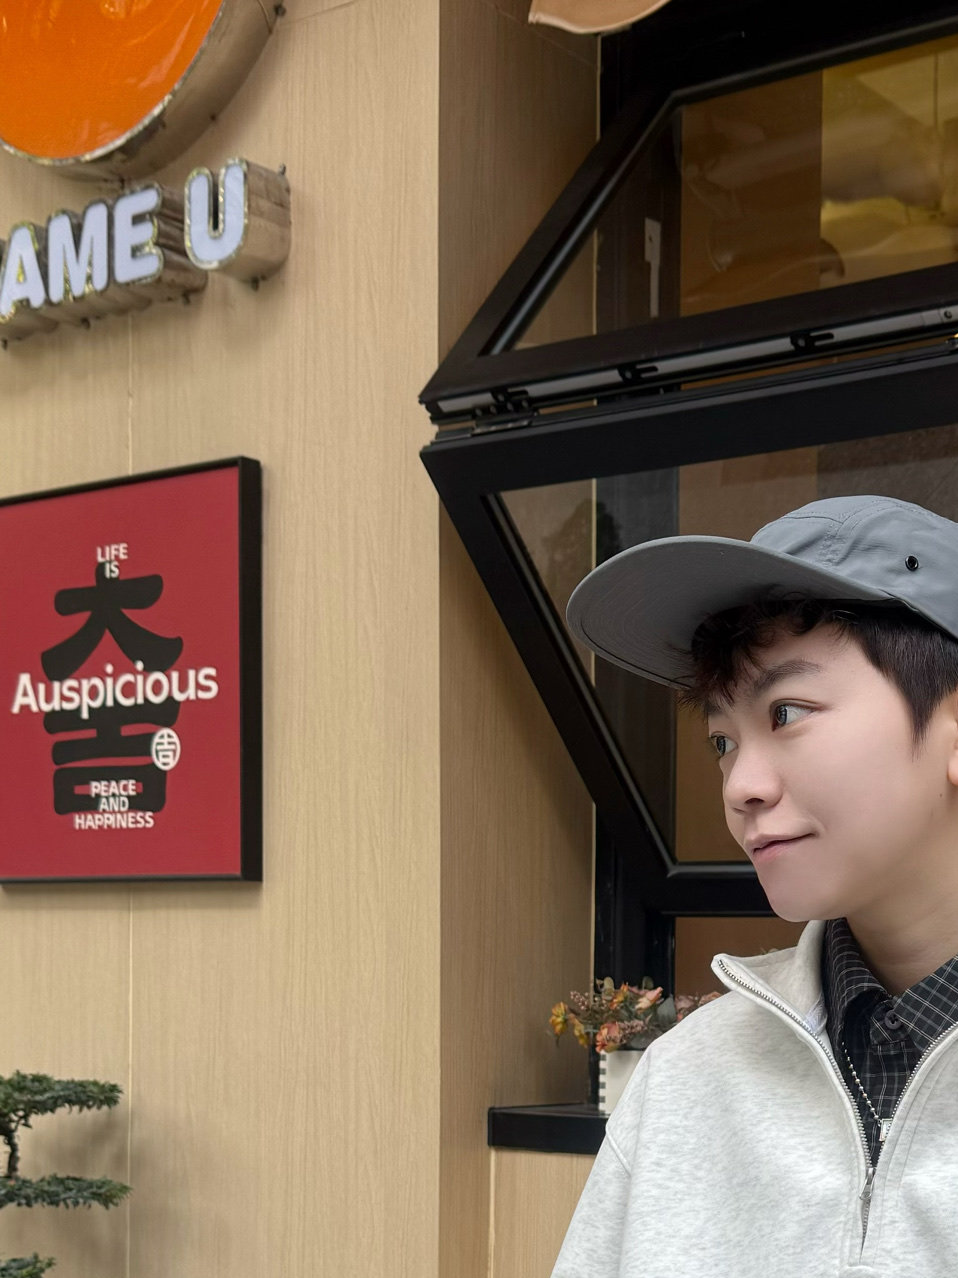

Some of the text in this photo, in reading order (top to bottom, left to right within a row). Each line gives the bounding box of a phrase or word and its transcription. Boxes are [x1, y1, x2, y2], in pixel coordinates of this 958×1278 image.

[184, 157, 249, 270] U
[97, 543, 128, 562] LIFE
[105, 561, 119, 578] IS
[11, 660, 219, 719] Auspicious
[90, 780, 137, 797] PEACE
[98, 797, 129, 812] AND
[74, 812, 154, 829] HAPPINESS
